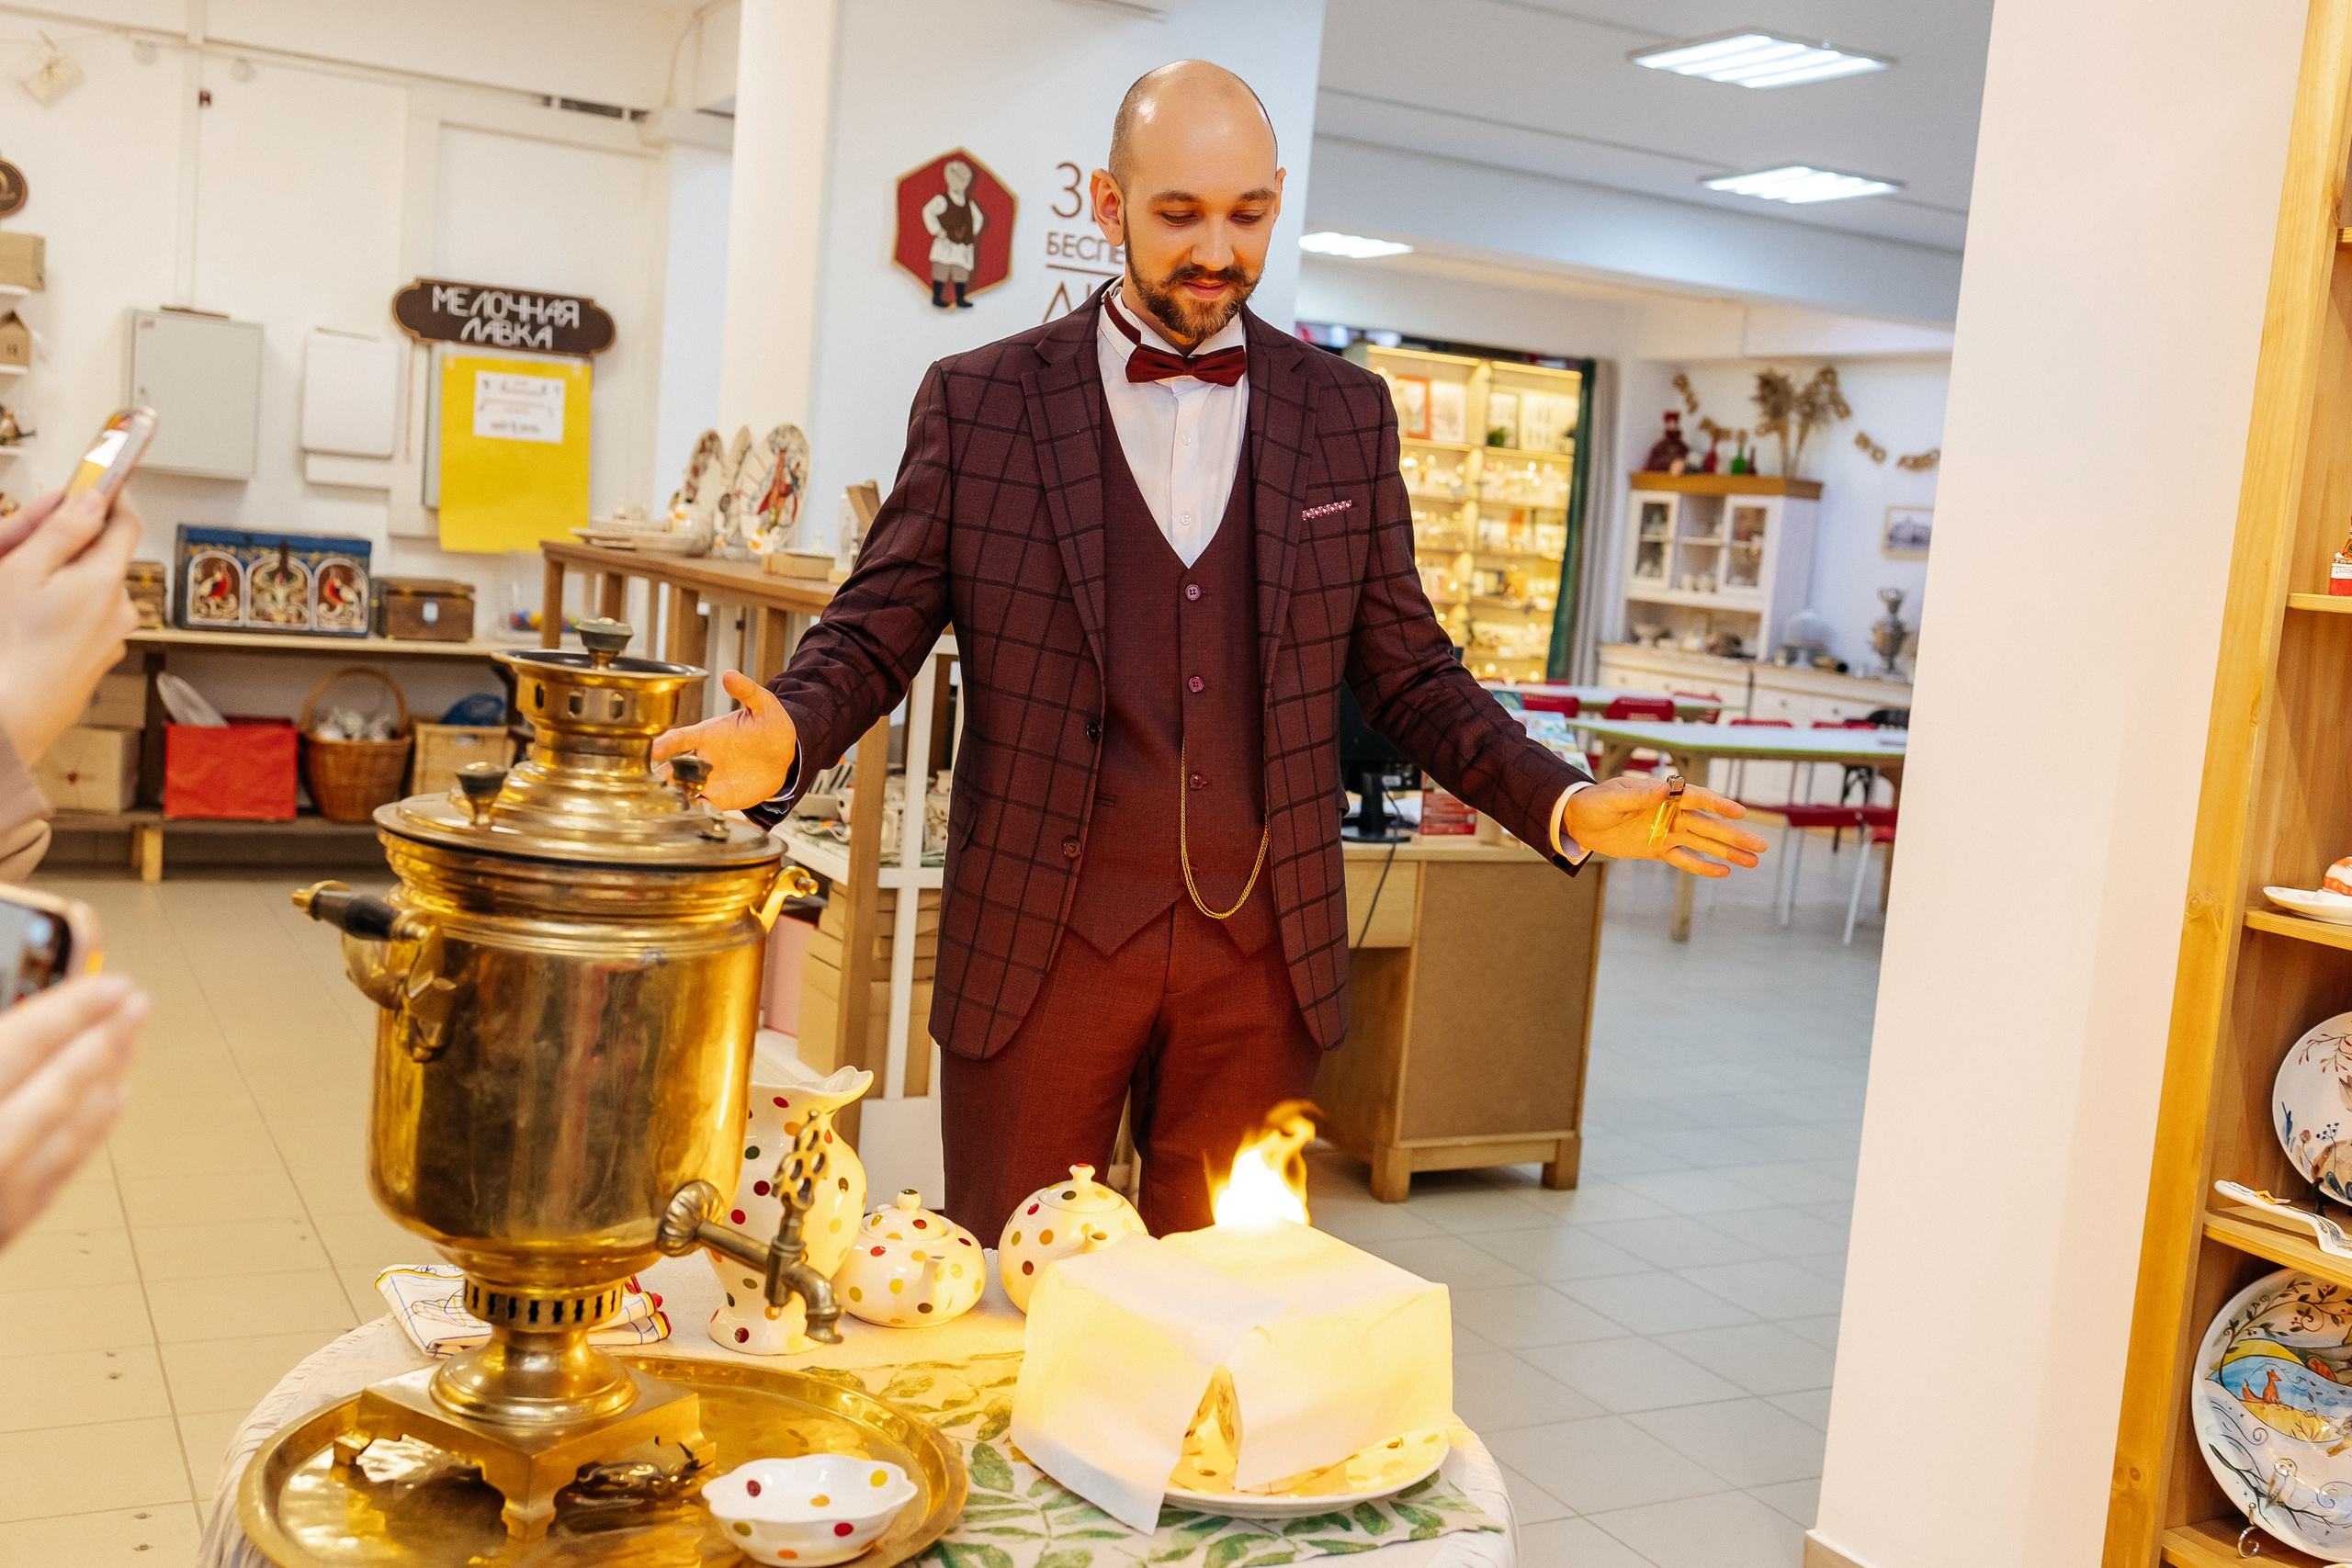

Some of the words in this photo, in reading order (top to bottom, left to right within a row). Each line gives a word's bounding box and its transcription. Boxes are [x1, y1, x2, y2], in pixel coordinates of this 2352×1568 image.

[1051, 161, 1098, 222] З
[432, 285, 581, 330] МЕЛОЧНАЯ
[459, 316, 554, 351] ЛАВКА
